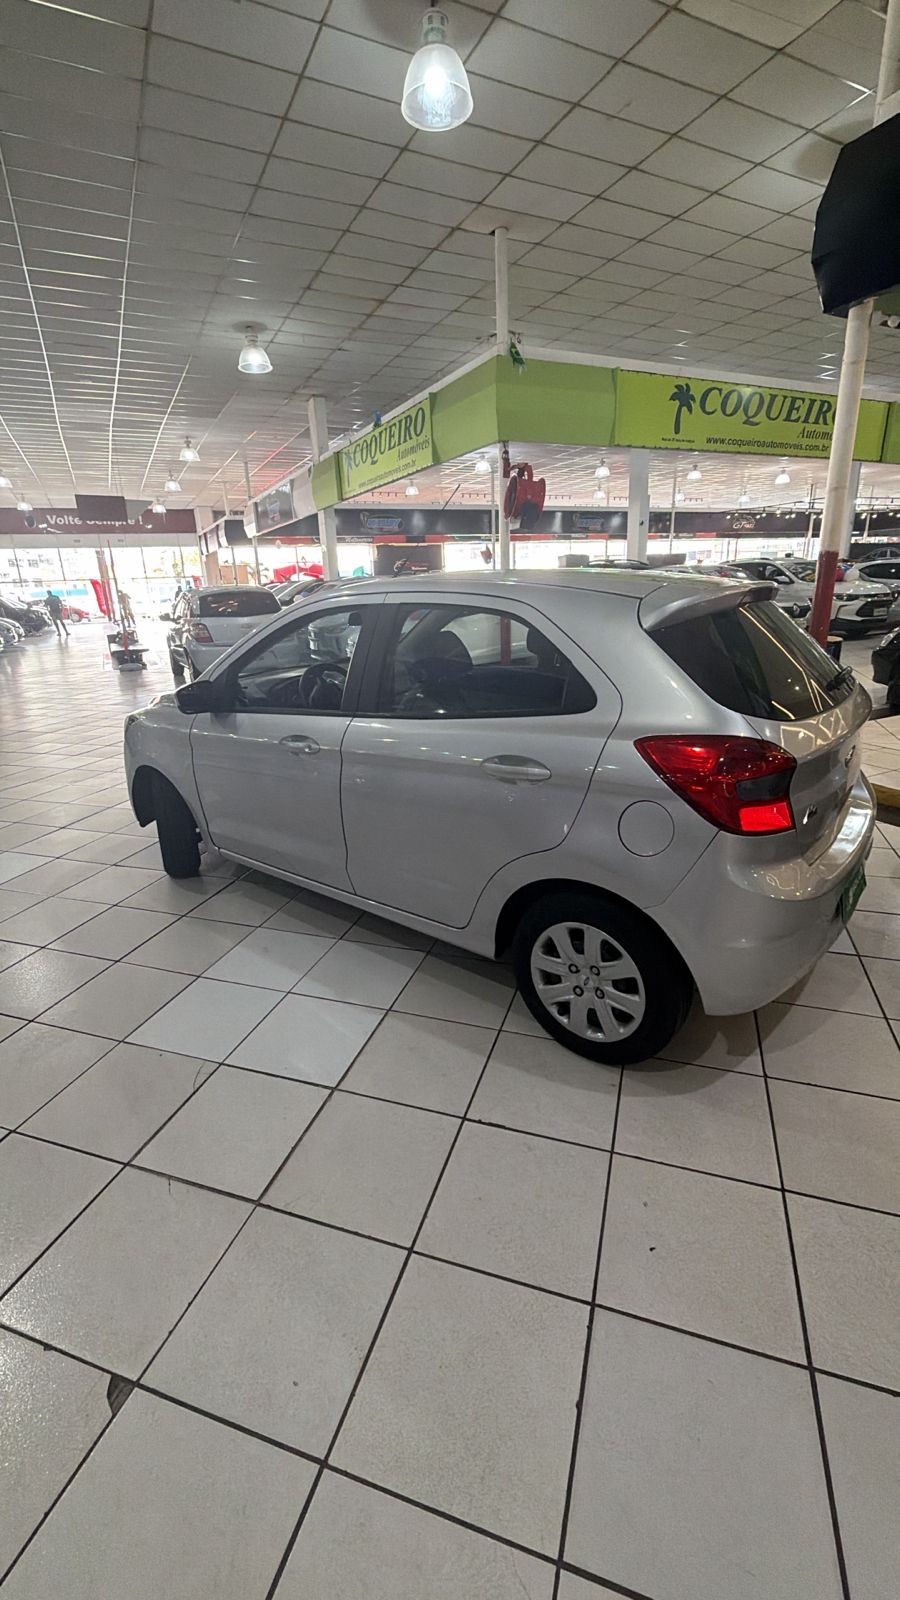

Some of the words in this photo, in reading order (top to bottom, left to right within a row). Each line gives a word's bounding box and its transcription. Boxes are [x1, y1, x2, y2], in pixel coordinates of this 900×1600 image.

[700, 386, 837, 426] COQUEIR
[353, 407, 425, 468] COQUEIRO
[706, 436, 830, 452] www.coqueiroautomoveis.com.br
[797, 426, 833, 441] Autom
